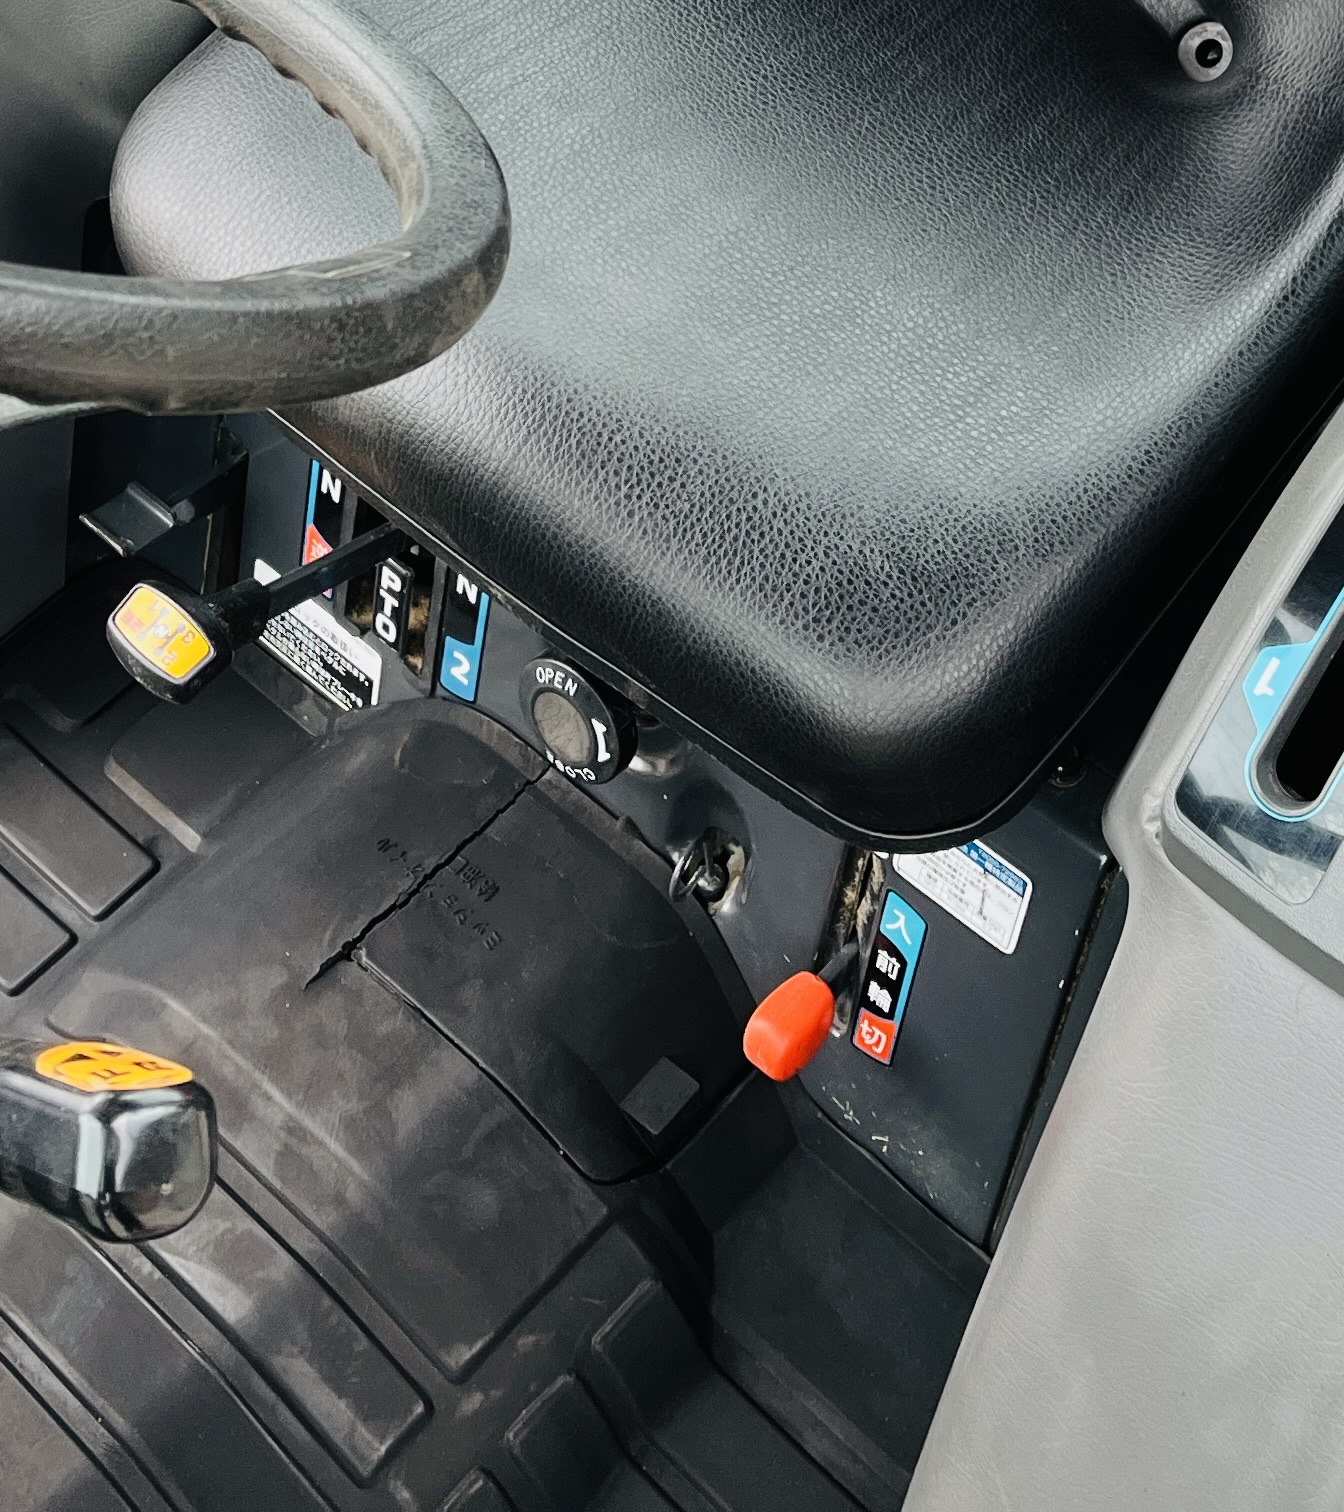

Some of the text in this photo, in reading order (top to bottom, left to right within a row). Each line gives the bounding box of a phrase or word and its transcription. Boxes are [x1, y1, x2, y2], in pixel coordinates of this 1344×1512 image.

[320, 469, 342, 504] N
[374, 565, 403, 643] PTO
[456, 573, 479, 605] N
[450, 650, 471, 686] 2
[536, 666, 578, 697] OPEN
[1251, 656, 1281, 698] 1
[885, 909, 913, 946] 入
[867, 948, 901, 1014] 前輪
[859, 1019, 888, 1054] 切
